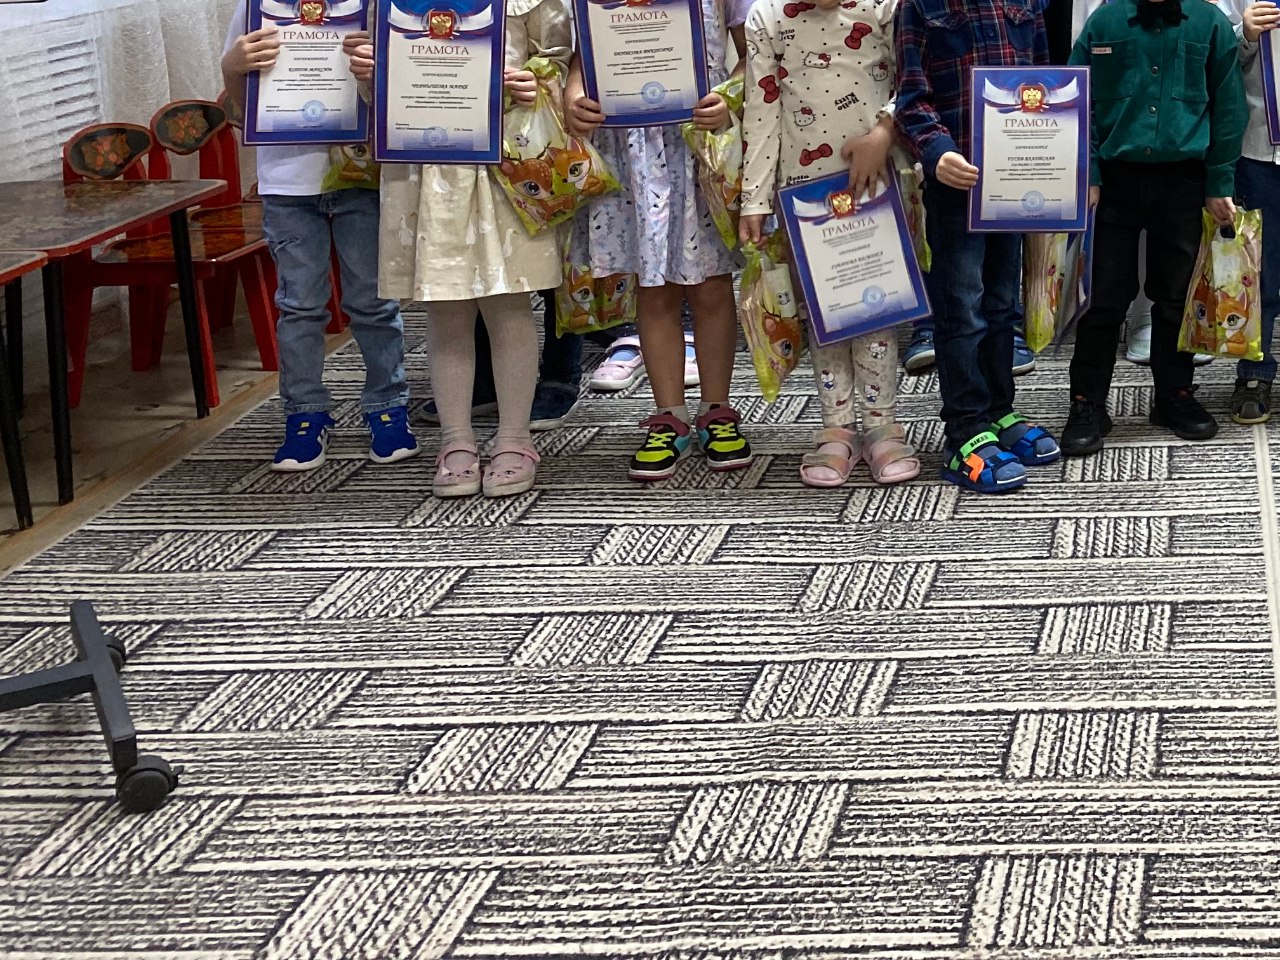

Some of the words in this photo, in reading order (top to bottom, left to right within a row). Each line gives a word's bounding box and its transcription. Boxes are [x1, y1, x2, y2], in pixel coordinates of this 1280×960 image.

[611, 10, 668, 24] ГРАМОТА
[282, 31, 340, 40] ГРАМОТА
[411, 45, 470, 55] ГРАМОТА
[1005, 118, 1059, 128] ГРАМОТА
[822, 216, 876, 238] ГРАМОТА
